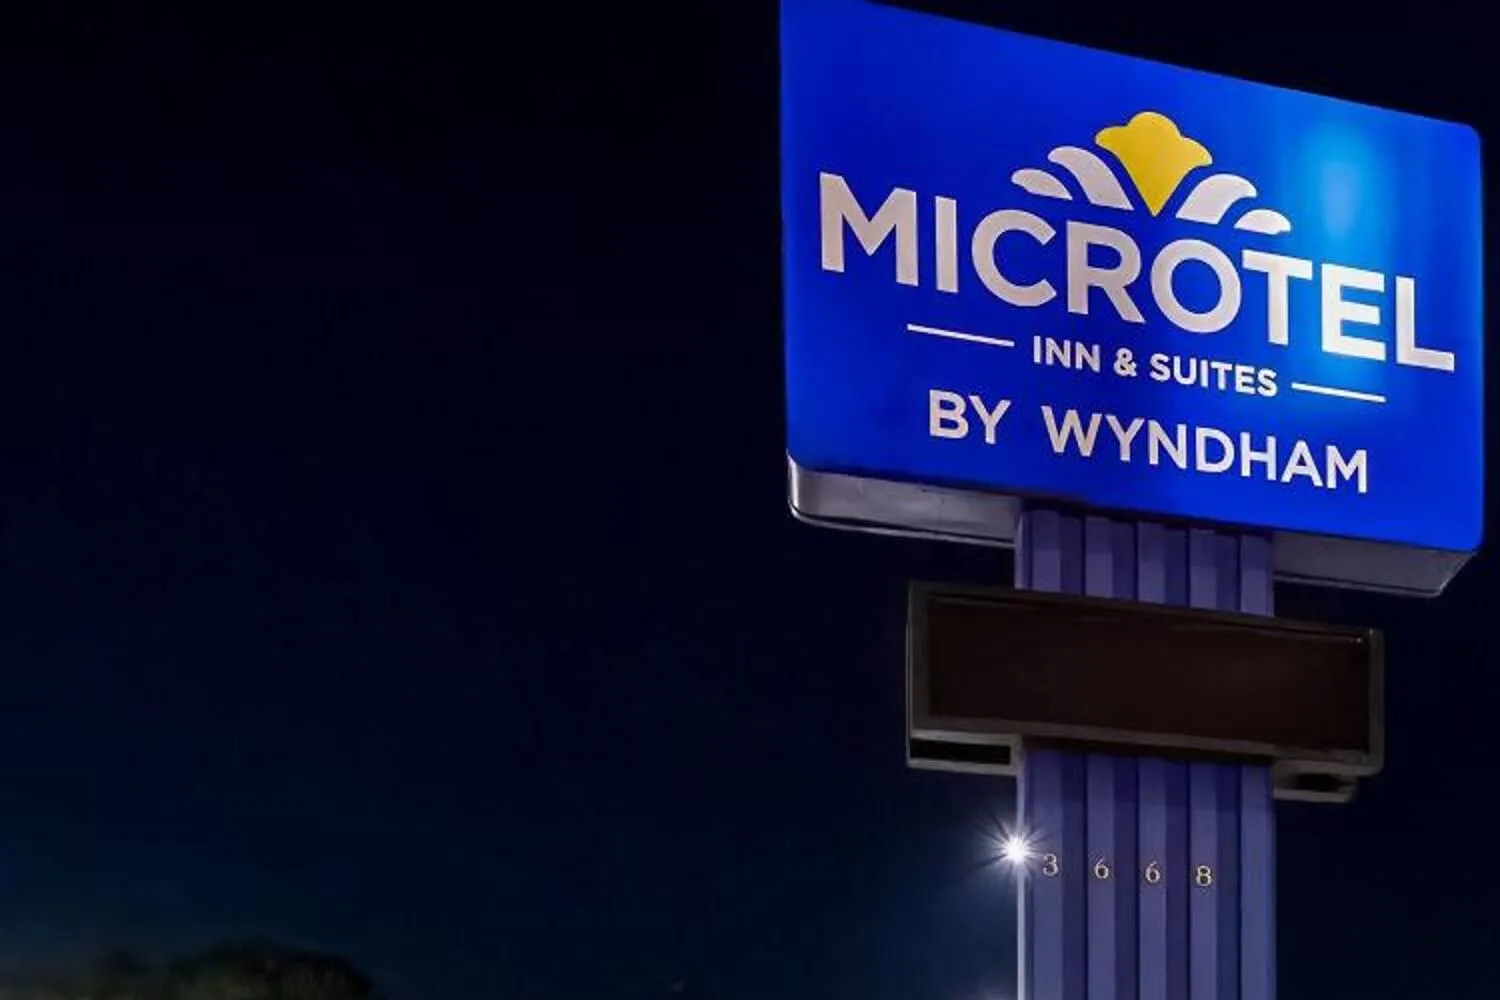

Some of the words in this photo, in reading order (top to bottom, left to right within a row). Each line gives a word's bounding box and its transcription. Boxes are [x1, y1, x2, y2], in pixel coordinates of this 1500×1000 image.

[819, 171, 1456, 373] MICROTEL
[1032, 334, 1101, 374] INN
[1113, 348, 1138, 378] &
[1150, 352, 1278, 397] SUITES
[928, 389, 1011, 445] BY
[1041, 405, 1369, 494] WYNDHAM
